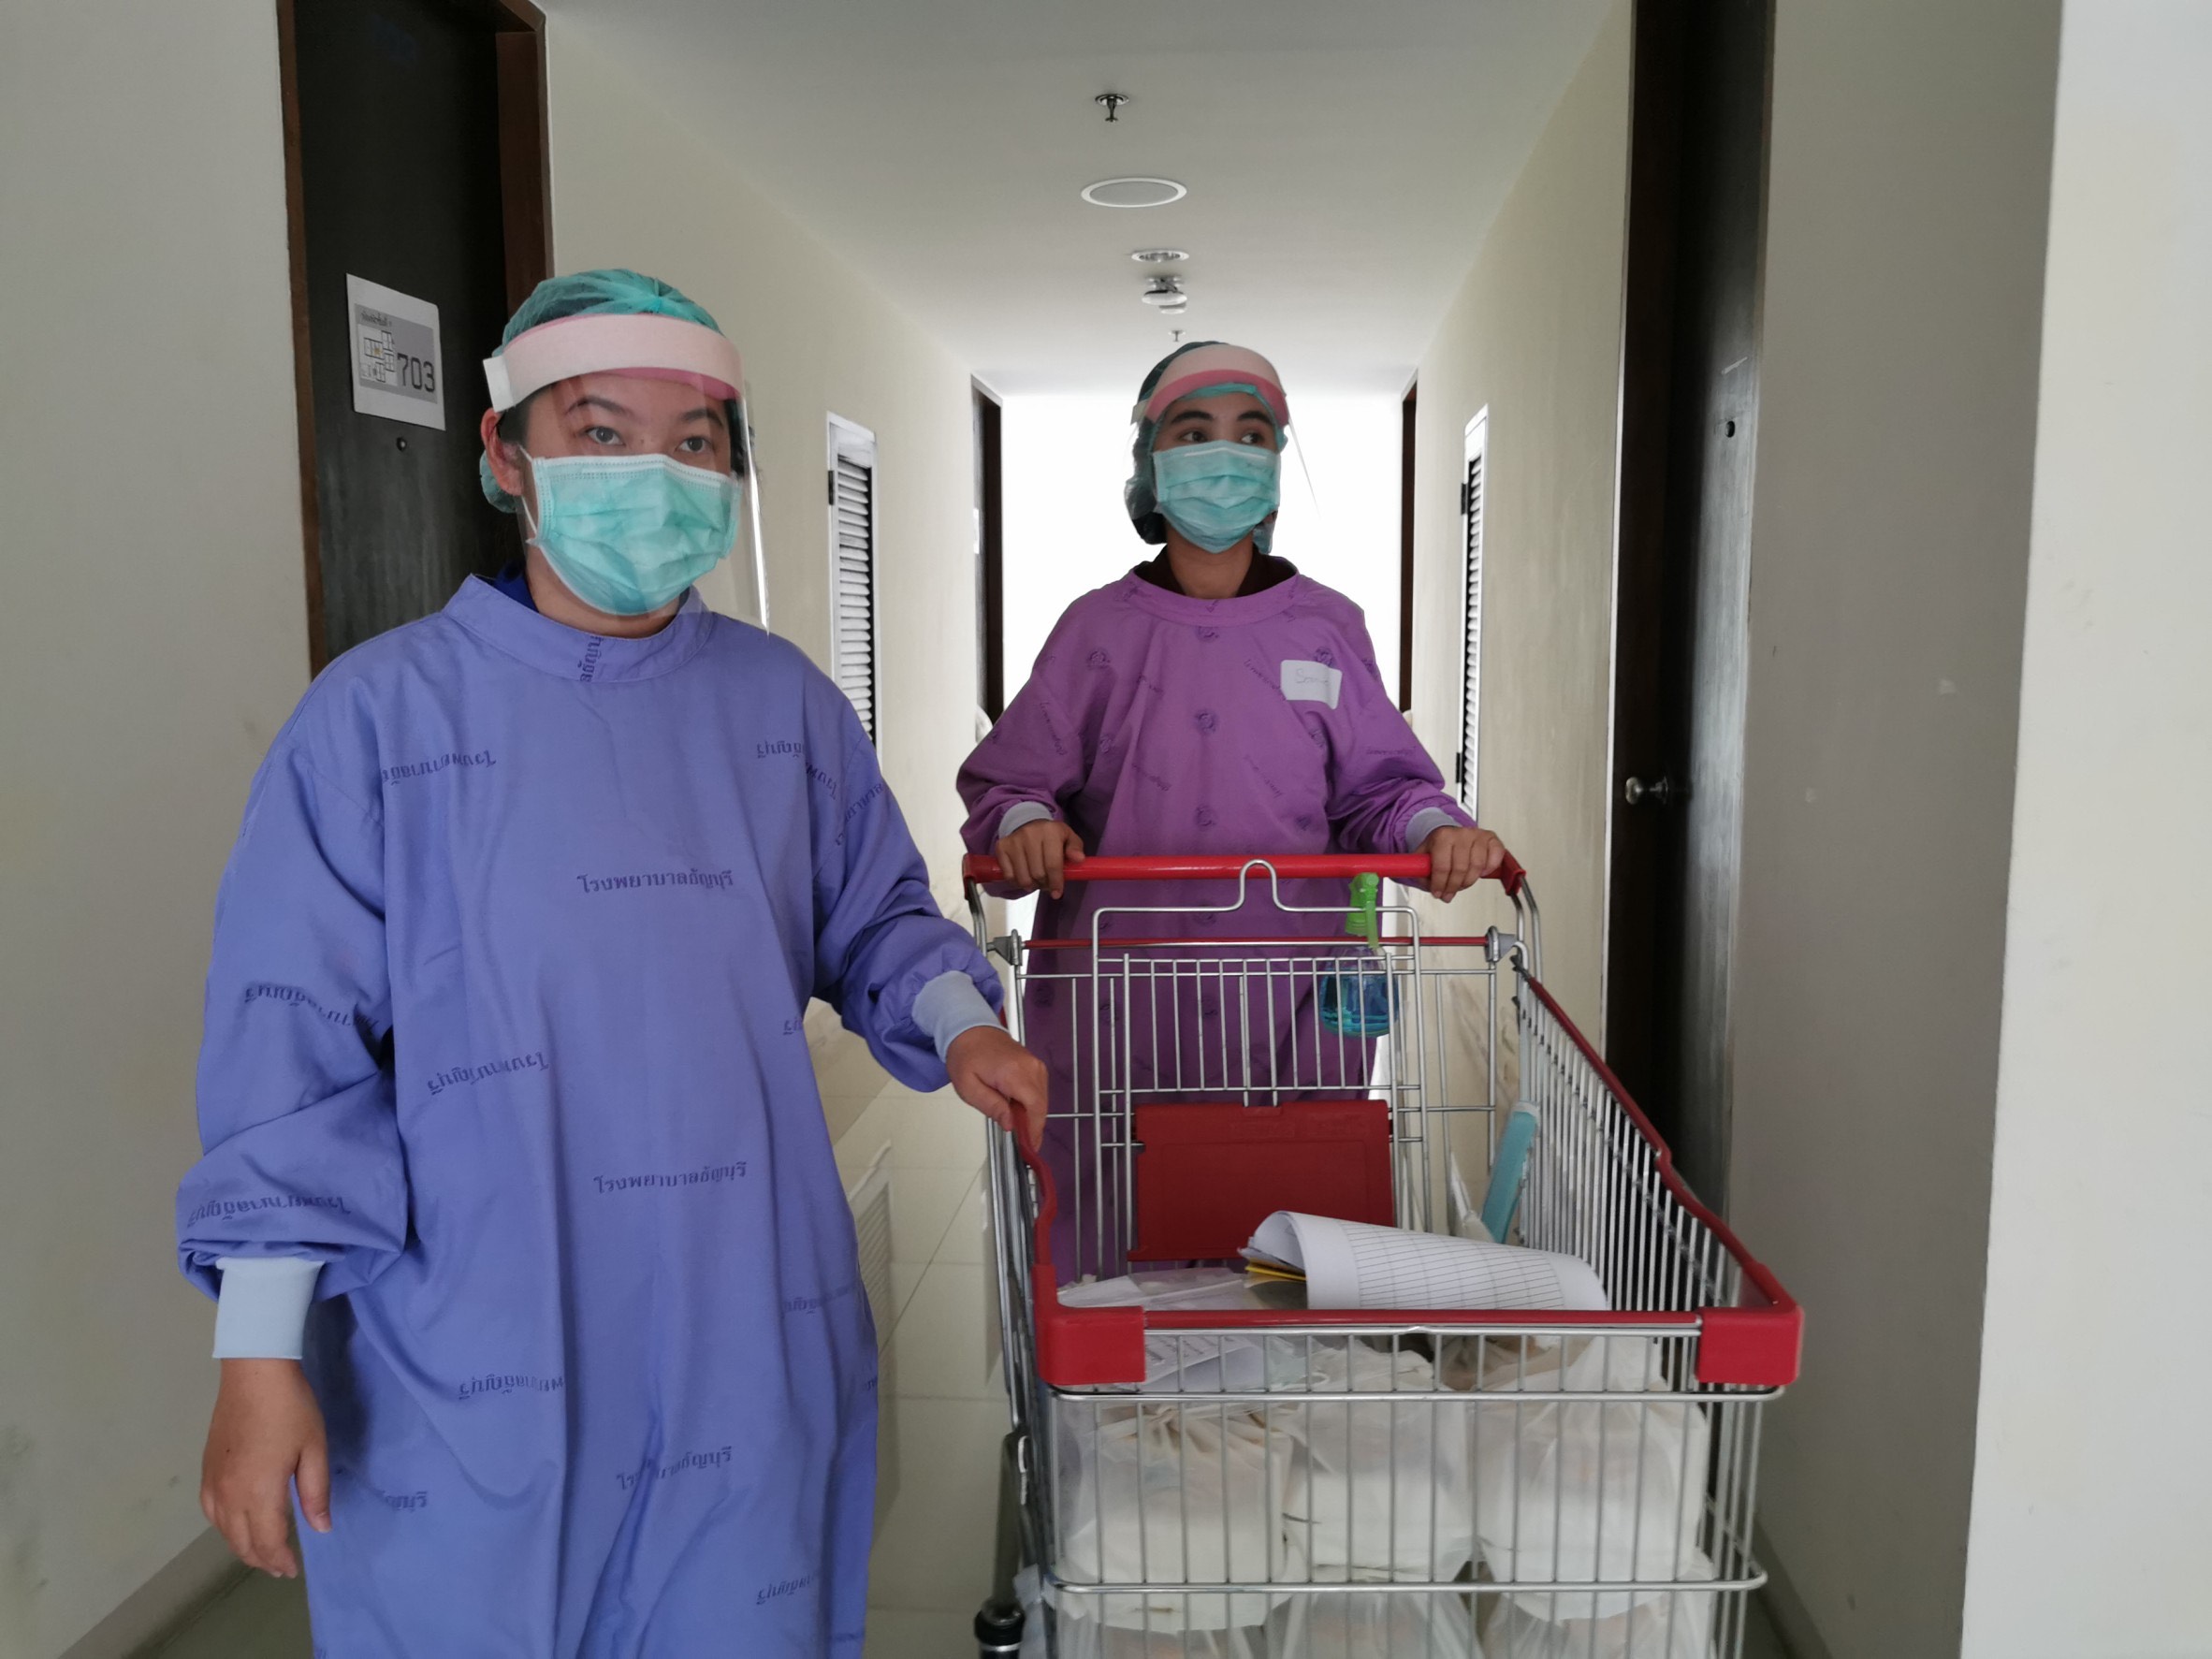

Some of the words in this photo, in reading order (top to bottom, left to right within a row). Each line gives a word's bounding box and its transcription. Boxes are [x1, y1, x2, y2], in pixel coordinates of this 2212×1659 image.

[398, 353, 435, 393] 703
[576, 868, 735, 893] โรงพยาบาลธัญบุรี
[593, 1161, 747, 1194] โรงพยาบาลธัญบุรี
